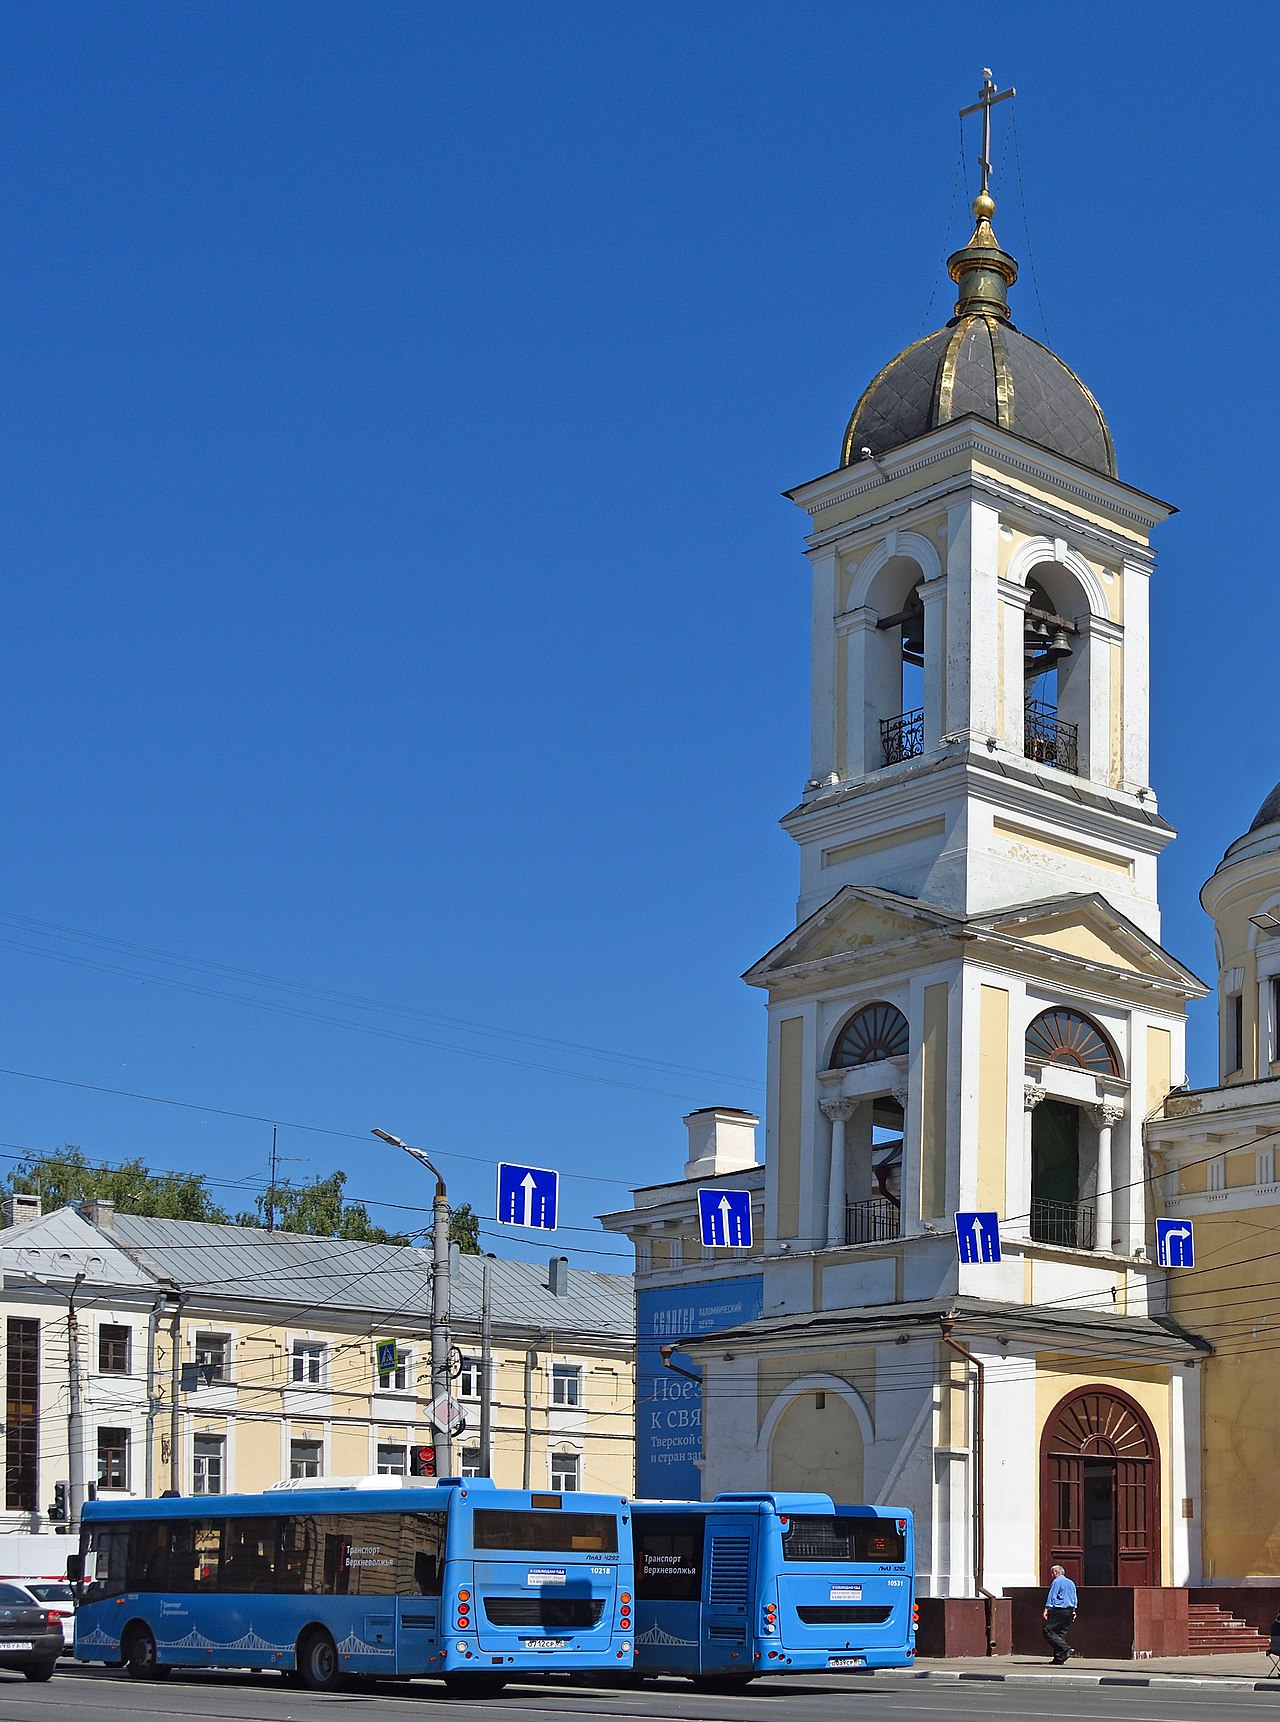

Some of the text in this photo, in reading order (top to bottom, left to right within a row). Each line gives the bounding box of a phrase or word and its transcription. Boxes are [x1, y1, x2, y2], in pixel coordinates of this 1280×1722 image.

[651, 1434, 695, 1449] Тверской
[658, 1452, 685, 1465] стран
[346, 1545, 381, 1556] Транспорт
[345, 1557, 394, 1569] Верхневолжья
[644, 1554, 682, 1565] Транспорт
[590, 1567, 611, 1575] 10218
[643, 1565, 696, 1576] Верхневолжья
